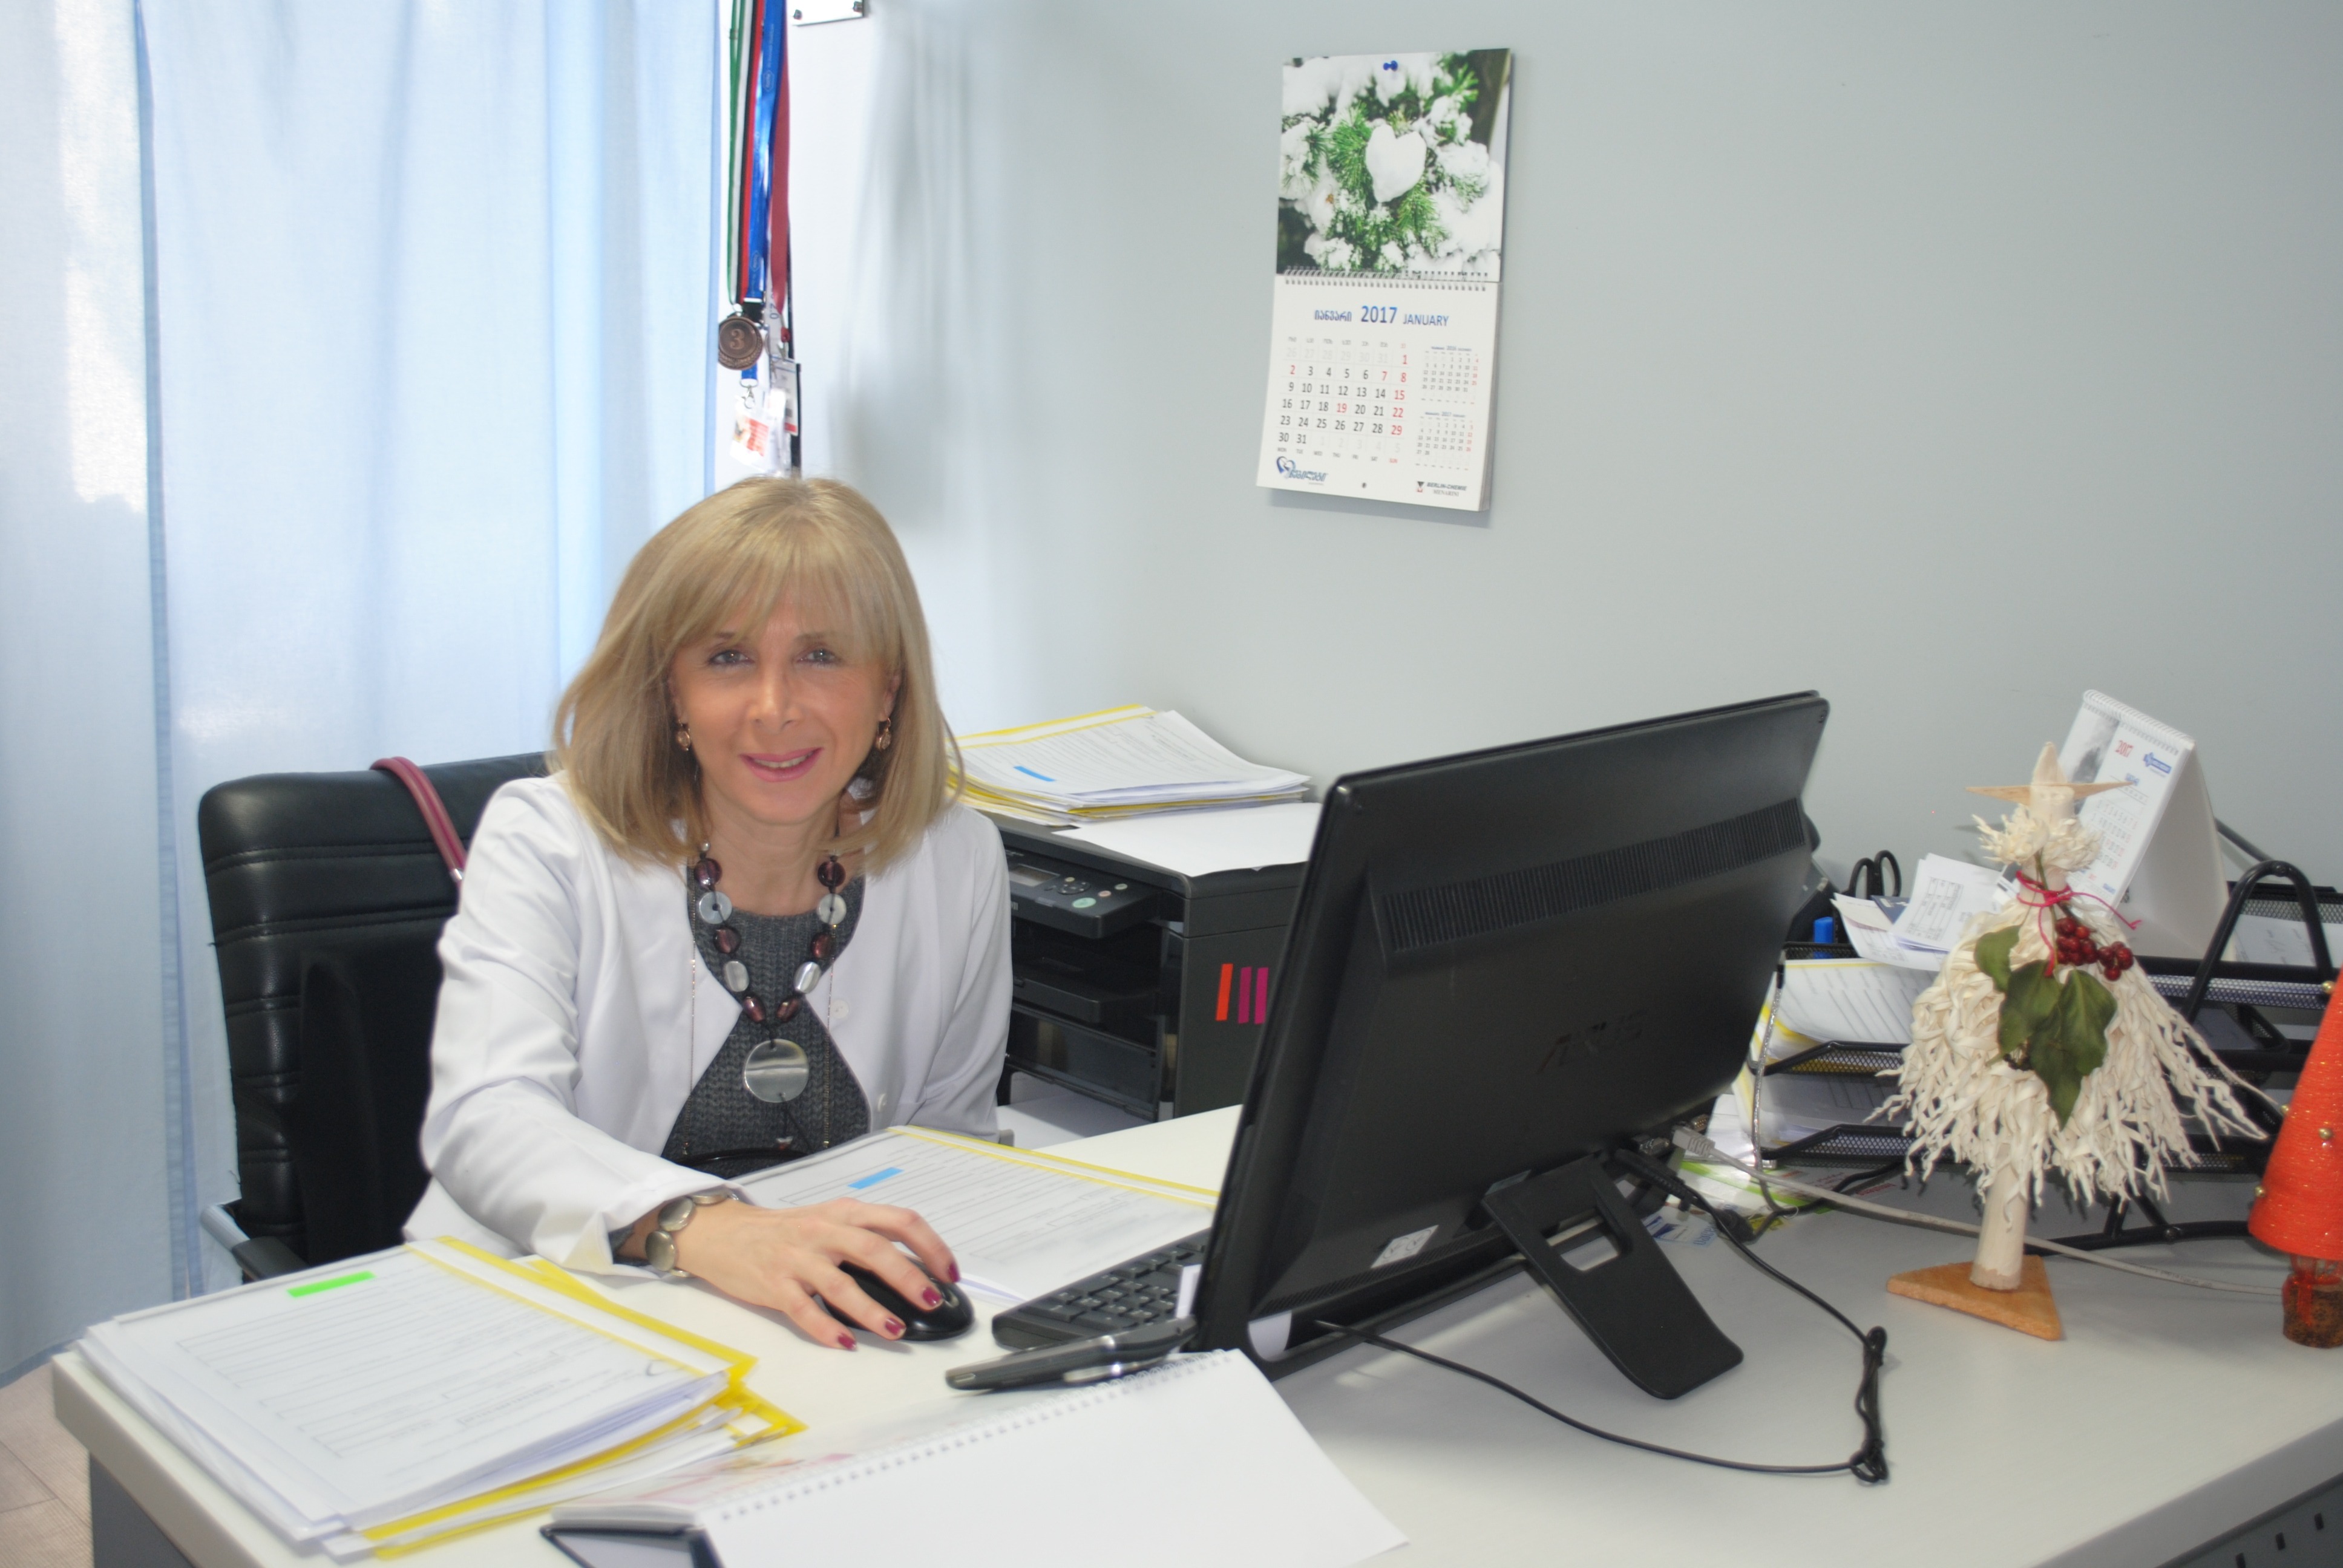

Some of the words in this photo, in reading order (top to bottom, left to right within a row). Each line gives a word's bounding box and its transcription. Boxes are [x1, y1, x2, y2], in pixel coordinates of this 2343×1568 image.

[1361, 305, 1398, 324] 2017
[1403, 313, 1449, 327] JANUARY
[729, 328, 747, 351] 3
[1403, 354, 1407, 365] 1
[1290, 365, 1296, 374] 2
[1308, 366, 1313, 376] 3
[1326, 367, 1331, 376] 4
[1345, 368, 1349, 379] 5
[1363, 370, 1368, 380] 6
[1382, 371, 1388, 381] 7
[1401, 372, 1406, 382] 8
[1289, 382, 1294, 391] 9
[1302, 383, 1312, 393] 10
[1320, 384, 1329, 394] 11
[1339, 386, 1348, 396] 12
[1357, 387, 1367, 397] 13
[1375, 388, 1386, 398] 14
[1394, 390, 1405, 400] 15
[1282, 399, 1293, 408] 16
[1300, 400, 1311, 410] 17
[1319, 402, 1329, 411] 18
[1337, 403, 1347, 413] 19
[1355, 404, 1366, 414] 20
[1374, 405, 1383, 416] 21
[1392, 407, 1403, 418] 22
[1280, 415, 1291, 425] 23
[1299, 417, 1308, 426] 24
[1317, 418, 1327, 428] 25
[1335, 420, 1345, 430] 26
[1353, 422, 1364, 431] 27
[1372, 423, 1383, 434] 28
[1391, 425, 1402, 436] 29
[1279, 432, 1289, 442] 30
[1297, 434, 1306, 444] 31
[2115, 740, 2134, 757] 2017
